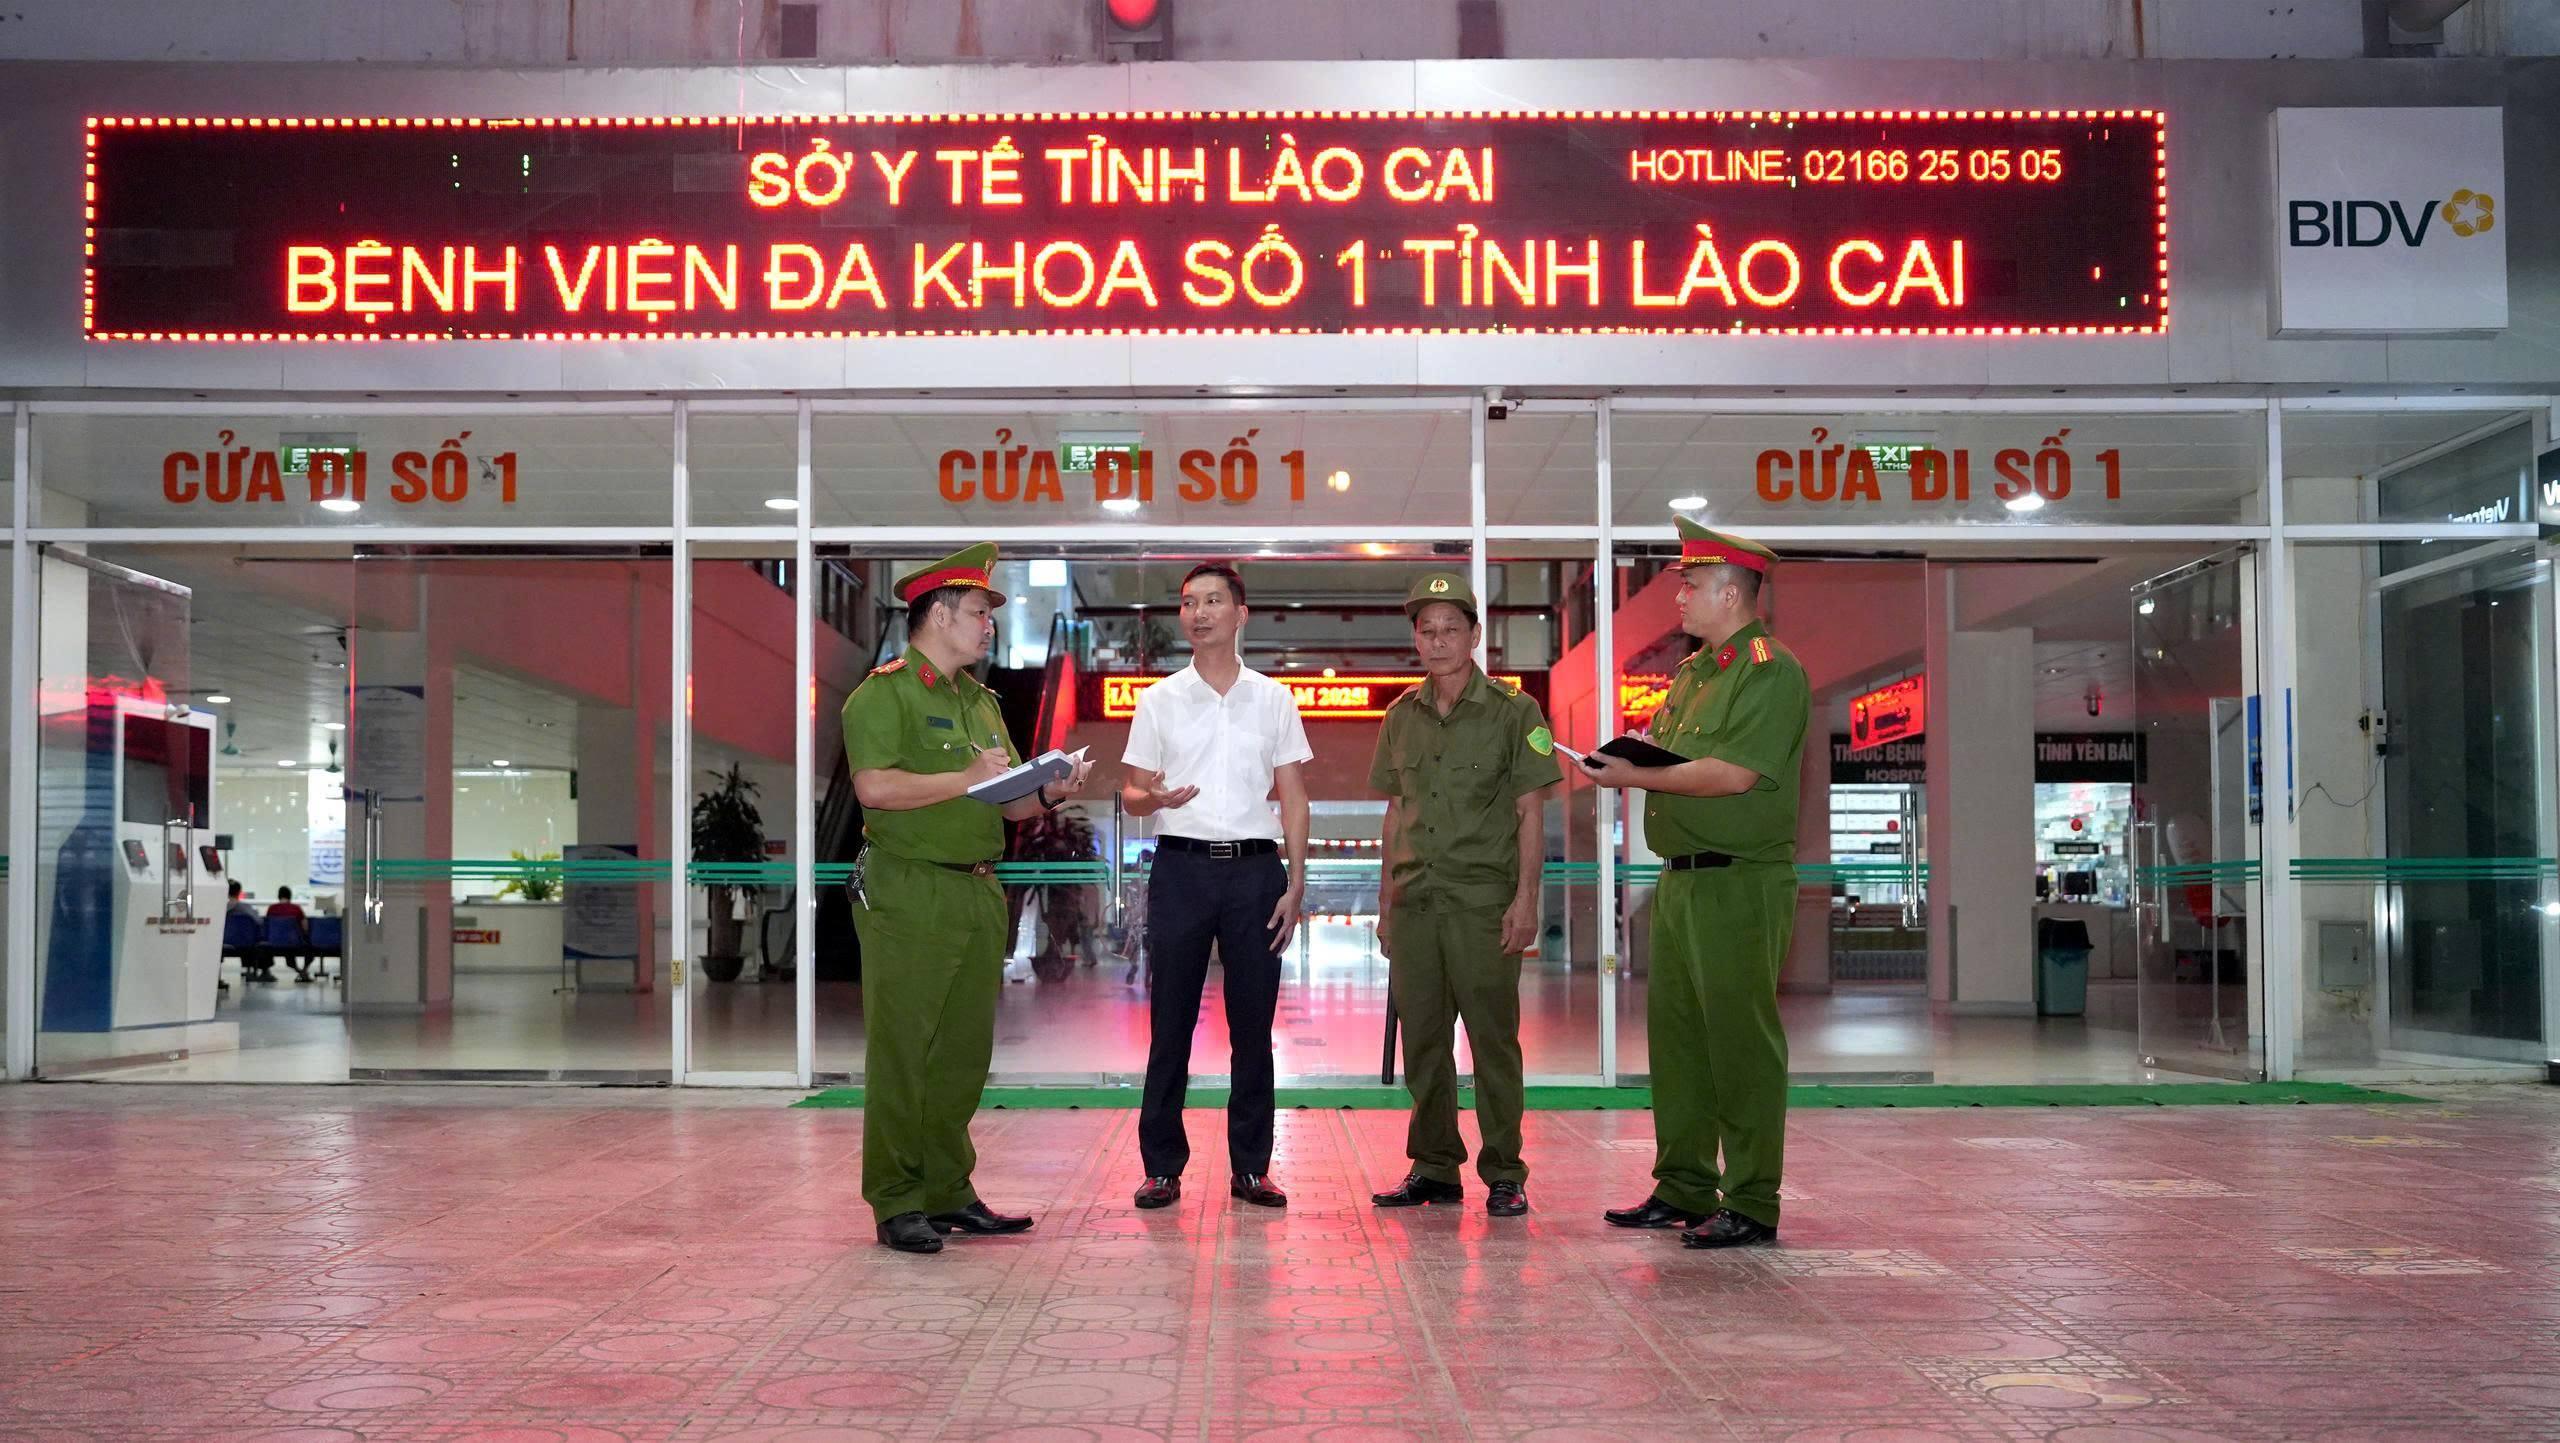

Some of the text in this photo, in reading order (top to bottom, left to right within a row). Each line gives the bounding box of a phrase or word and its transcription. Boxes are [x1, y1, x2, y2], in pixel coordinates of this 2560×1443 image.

[748, 133, 1492, 206] SỞ Y TẾ TỈNH LÀO CAI
[1632, 149, 2062, 181] HOTLINE: 02166 25 05 05
[2289, 200, 2441, 247] BIDV
[287, 223, 1963, 323] BỆNH VIỆN ĐA KHOA SỐ 1 TỈNH LÀO CAI
[163, 430, 517, 503] CỬA ĐI SỐ 1
[938, 428, 1304, 502] CỬA ĐI SỐ 1
[1756, 427, 2120, 502] CỬA ĐI SỐ 1
[2076, 740, 2105, 761] YÊN
[2108, 738, 2133, 761] BÁI
